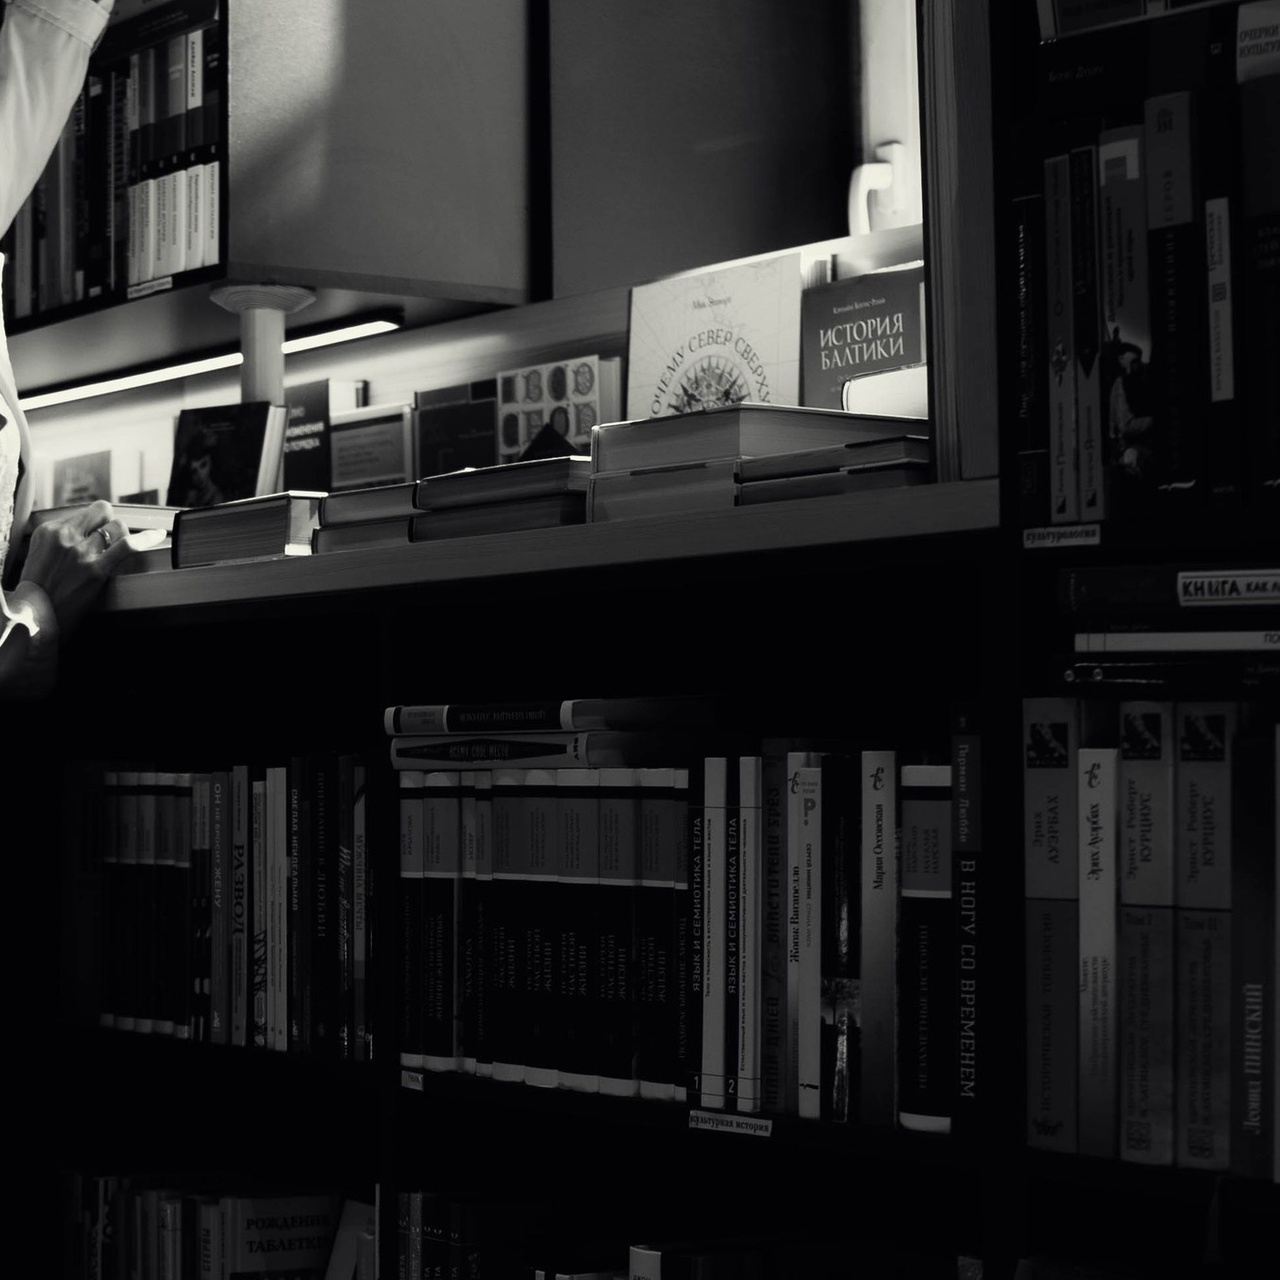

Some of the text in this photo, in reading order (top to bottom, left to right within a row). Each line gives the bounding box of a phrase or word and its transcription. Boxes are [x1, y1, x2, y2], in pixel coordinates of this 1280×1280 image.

[1240, 24, 1279, 44] ОЧЕРКИ
[820, 313, 904, 349] ИСТОРИЯ
[821, 336, 905, 370] БАЛТИКИ
[650, 344, 685, 415] ОЧЕМУ
[688, 328, 733, 353] СЕВЕР
[1182, 581, 1269, 597] КНИГА КАК
[958, 744, 970, 842] Герман Люббе
[1140, 792, 1153, 862] КУРЦИУС
[872, 804, 886, 890] Мария Оссовская
[1033, 812, 1044, 847] Эрих
[1047, 795, 1060, 864] АУЭРБАХ
[1086, 803, 1103, 880] Эрих Ауэрбах
[1126, 778, 1138, 880] Эрнст Роберт
[1187, 781, 1199, 883] Эрнст Роберт
[1202, 795, 1216, 867] КУРЦИУС
[233, 844, 245, 934] РАЗВОД
[317, 864, 326, 938] ЛЮБВИ
[355, 833, 364, 931] МУЖЧИНА МЕЧТЫ
[692, 817, 702, 992] ЯЗЫК И СЕМИОТИКА ТЕЛА
[728, 818, 737, 994] ЯЗЫК И СЕМИОТИКА ТЕЛА
[789, 865, 800, 963] Жорж Вигарелло
[508, 938, 516, 988] ЖИЗНИ
[543, 941, 552, 992] ЖИЗНИ
[578, 944, 588, 996] ЖИЗНИ
[617, 947, 626, 1000] ЖИЗНИ
[657, 950, 666, 1002] ЖИЗНИ
[960, 860, 976, 1098] В НОГУ СО ВРЕМЕНЕМ
[694, 1076, 700, 1090] 1
[728, 1079, 736, 1094] 2
[1242, 983, 1264, 1134] Леонид ПИНСКИЙ
[690, 1115, 769, 1133] культурная история
[246, 1213, 331, 1231] РОЖДЕНИЕ
